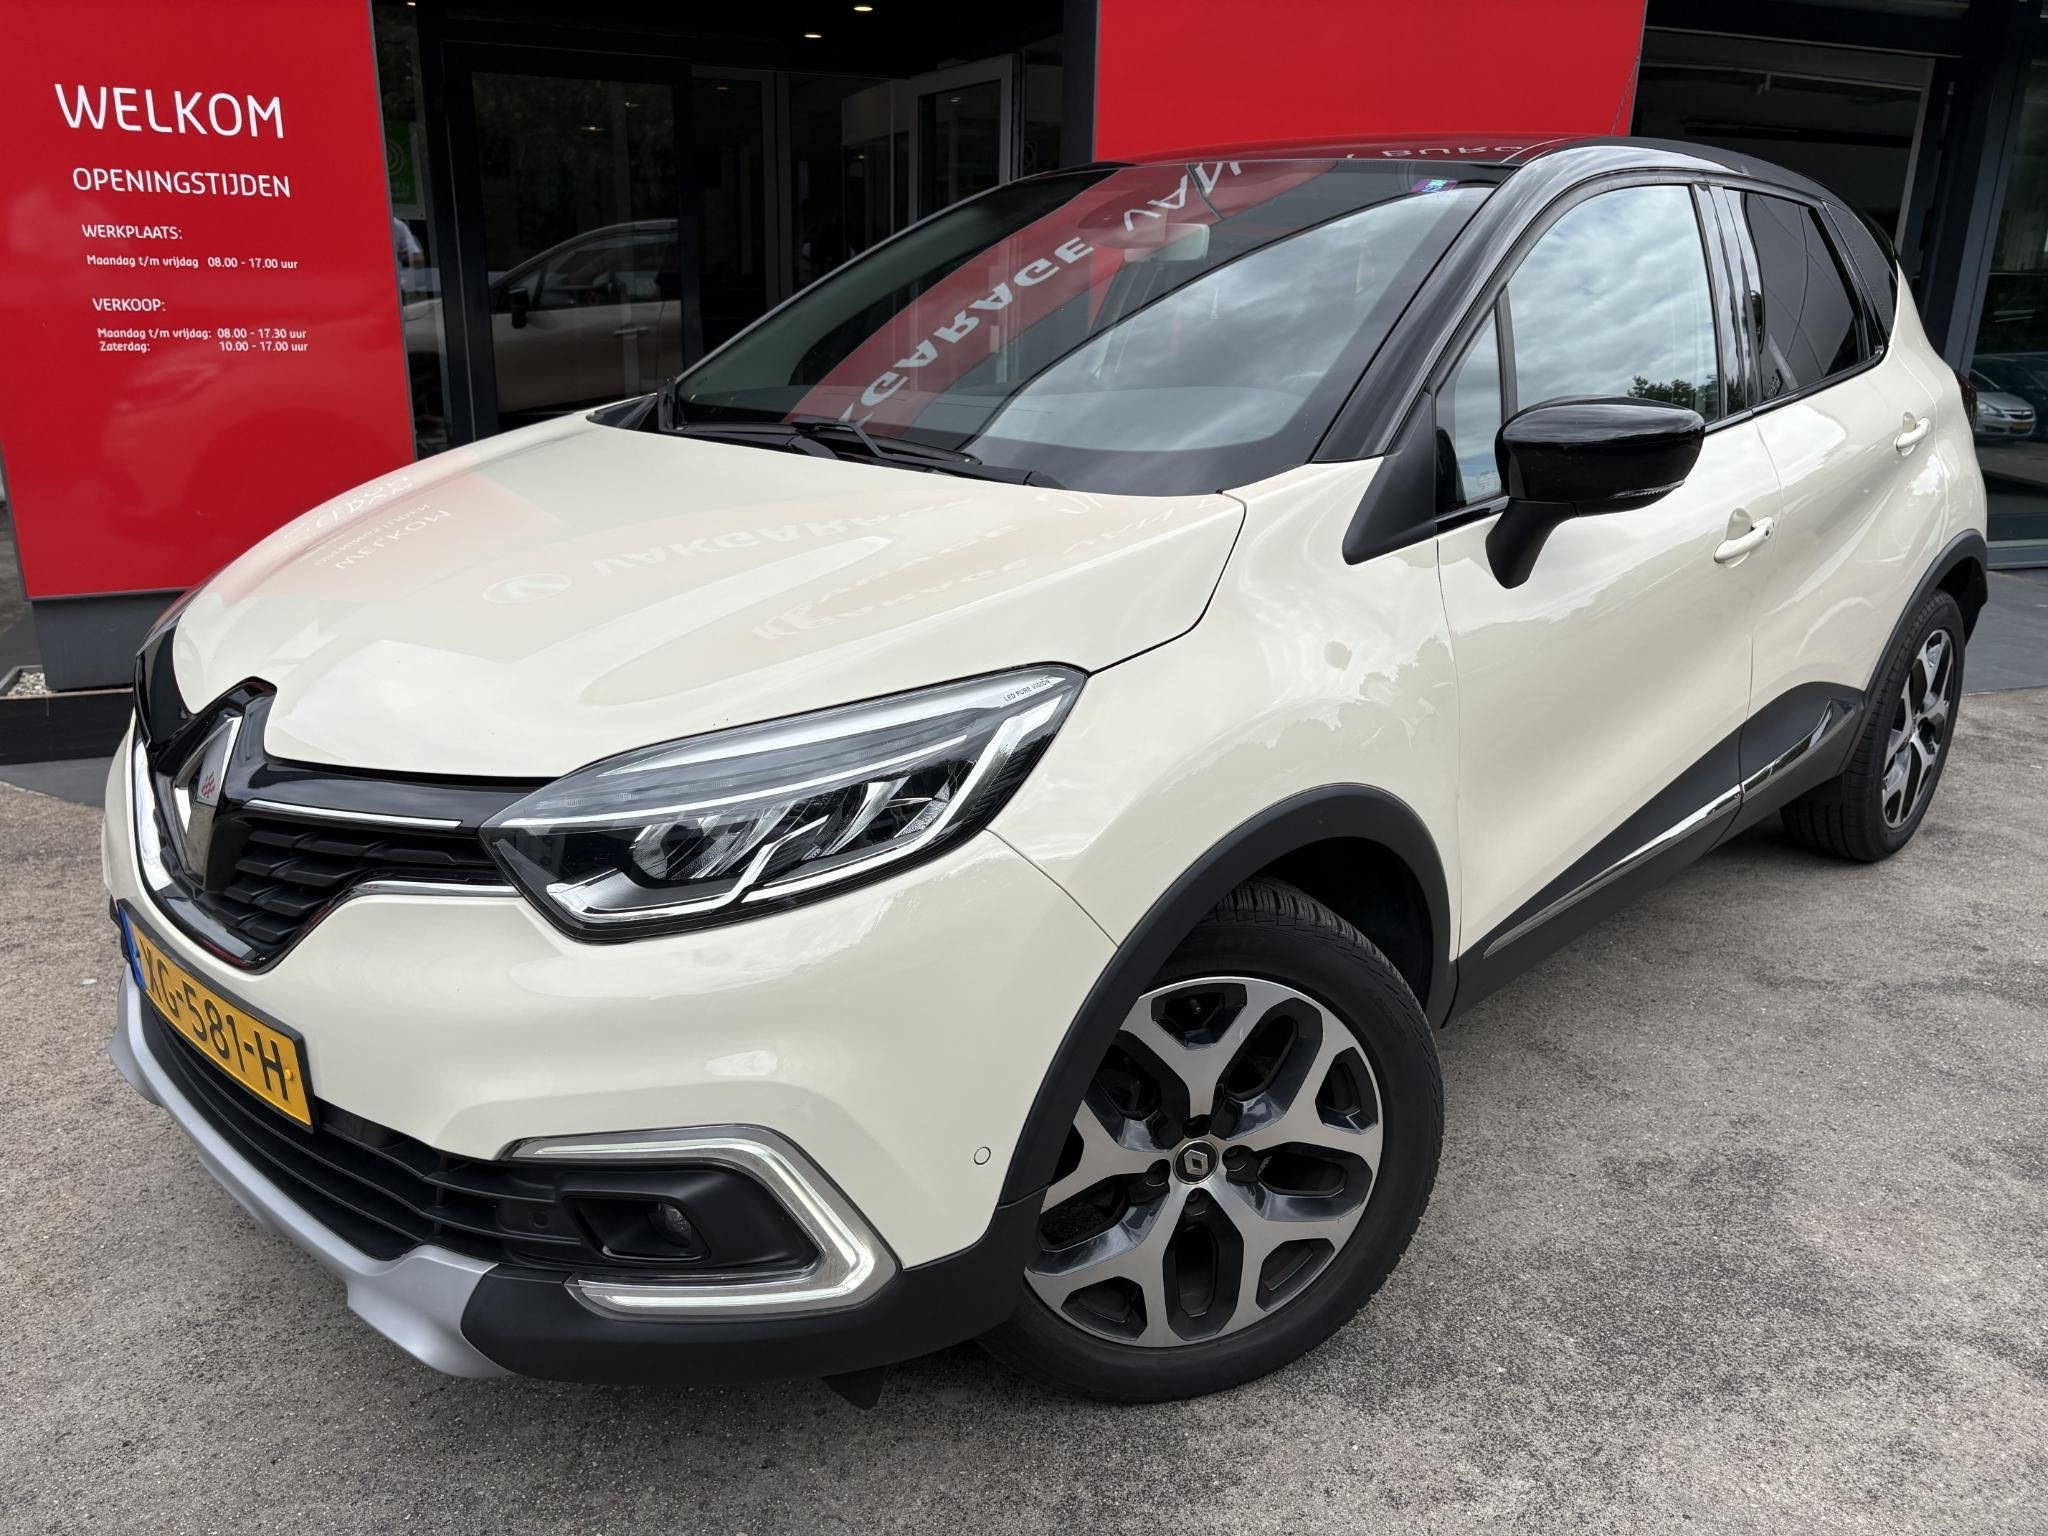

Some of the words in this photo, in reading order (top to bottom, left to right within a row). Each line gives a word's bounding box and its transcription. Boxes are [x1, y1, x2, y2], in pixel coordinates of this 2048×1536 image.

[54, 83, 284, 139] WELKOM
[72, 167, 291, 198] OPENINGSTIJDEN
[81, 224, 183, 240] WERKPLAATS:
[86, 255, 136, 268] Maandag
[138, 255, 160, 267] t/m
[162, 256, 199, 269] vrijdag
[207, 257, 238, 268] 08.00
[248, 258, 278, 269] 17.00
[281, 261, 299, 269] uur
[92, 298, 166, 312] VERKOOP:
[97, 328, 146, 340] Maandag
[148, 328, 170, 339] t/m
[172, 328, 212, 340] vrijdag:
[217, 328, 247, 339] 08.00
[257, 328, 287, 339] 17.30
[289, 330, 307, 339] uur
[99, 341, 151, 353] Zaterdag:
[219, 341, 249, 352] 10.00
[259, 341, 289, 352] 17.00
[291, 343, 309, 352] uur
[1004, 692, 1016, 702] LED
[1015, 686, 1032, 697] PURE
[1032, 679, 1051, 690] VISION
[139, 936, 289, 1101] XG-581-H
